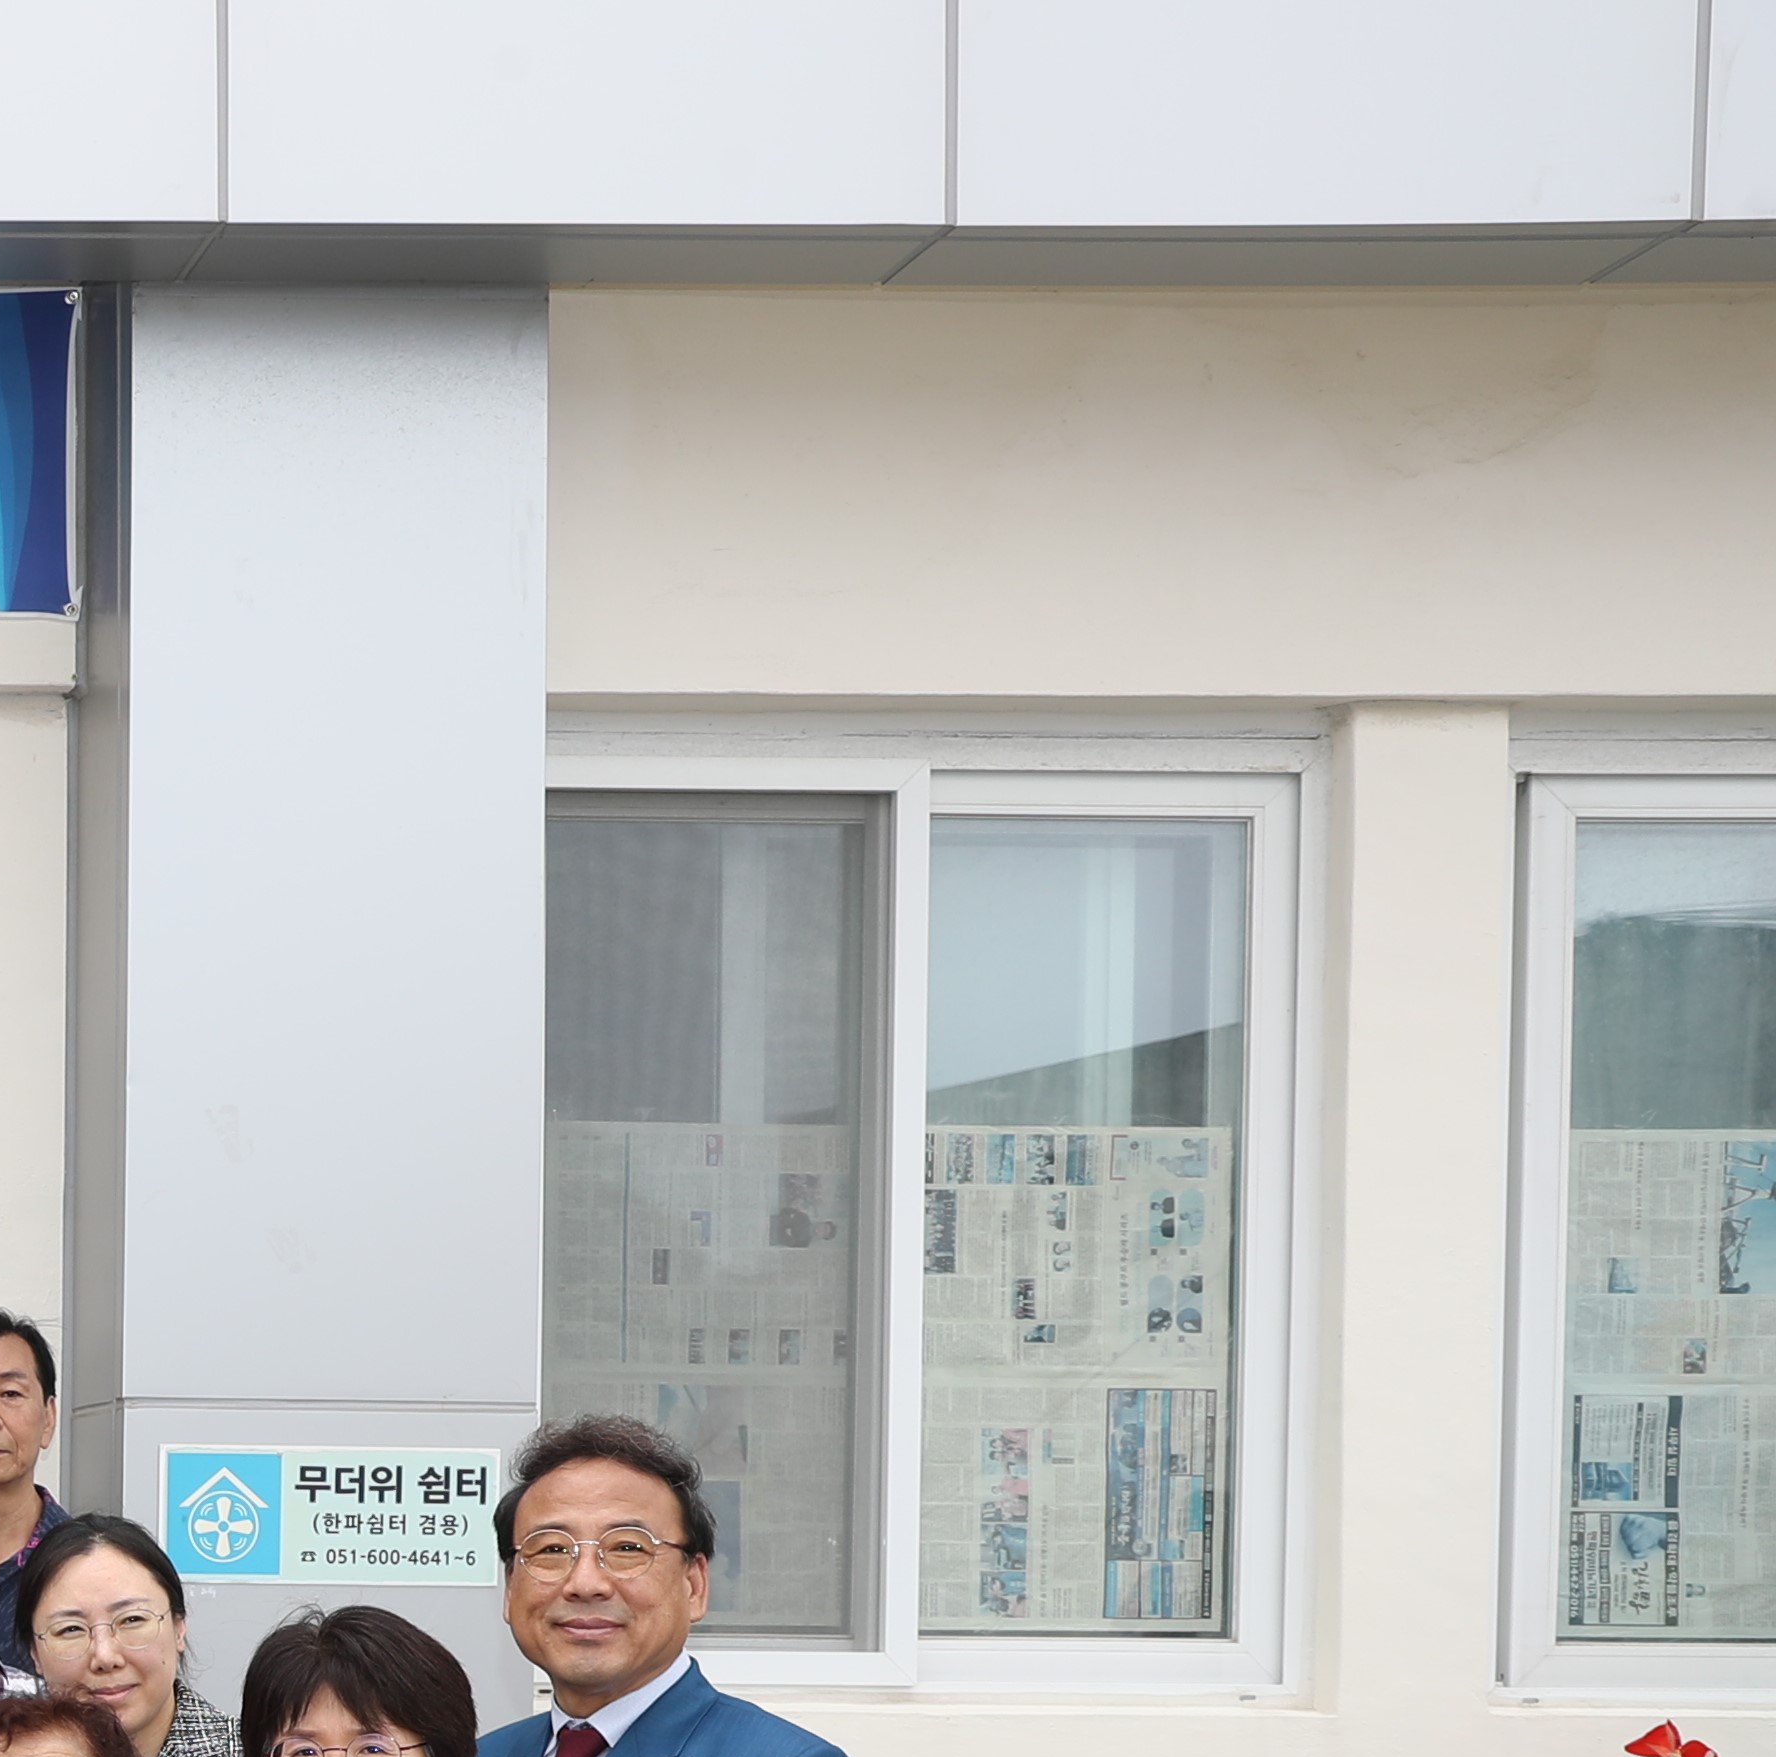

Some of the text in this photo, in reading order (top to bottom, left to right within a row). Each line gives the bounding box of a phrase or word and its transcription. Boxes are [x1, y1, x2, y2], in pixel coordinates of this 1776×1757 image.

[1666, 1426, 1679, 1477] 사무실 임대
[294, 1465, 488, 1506] 무더위 쉼터
[312, 1512, 470, 1537] (한파쉼터 겸용)
[326, 1548, 477, 1567] 051-600-4641~6
